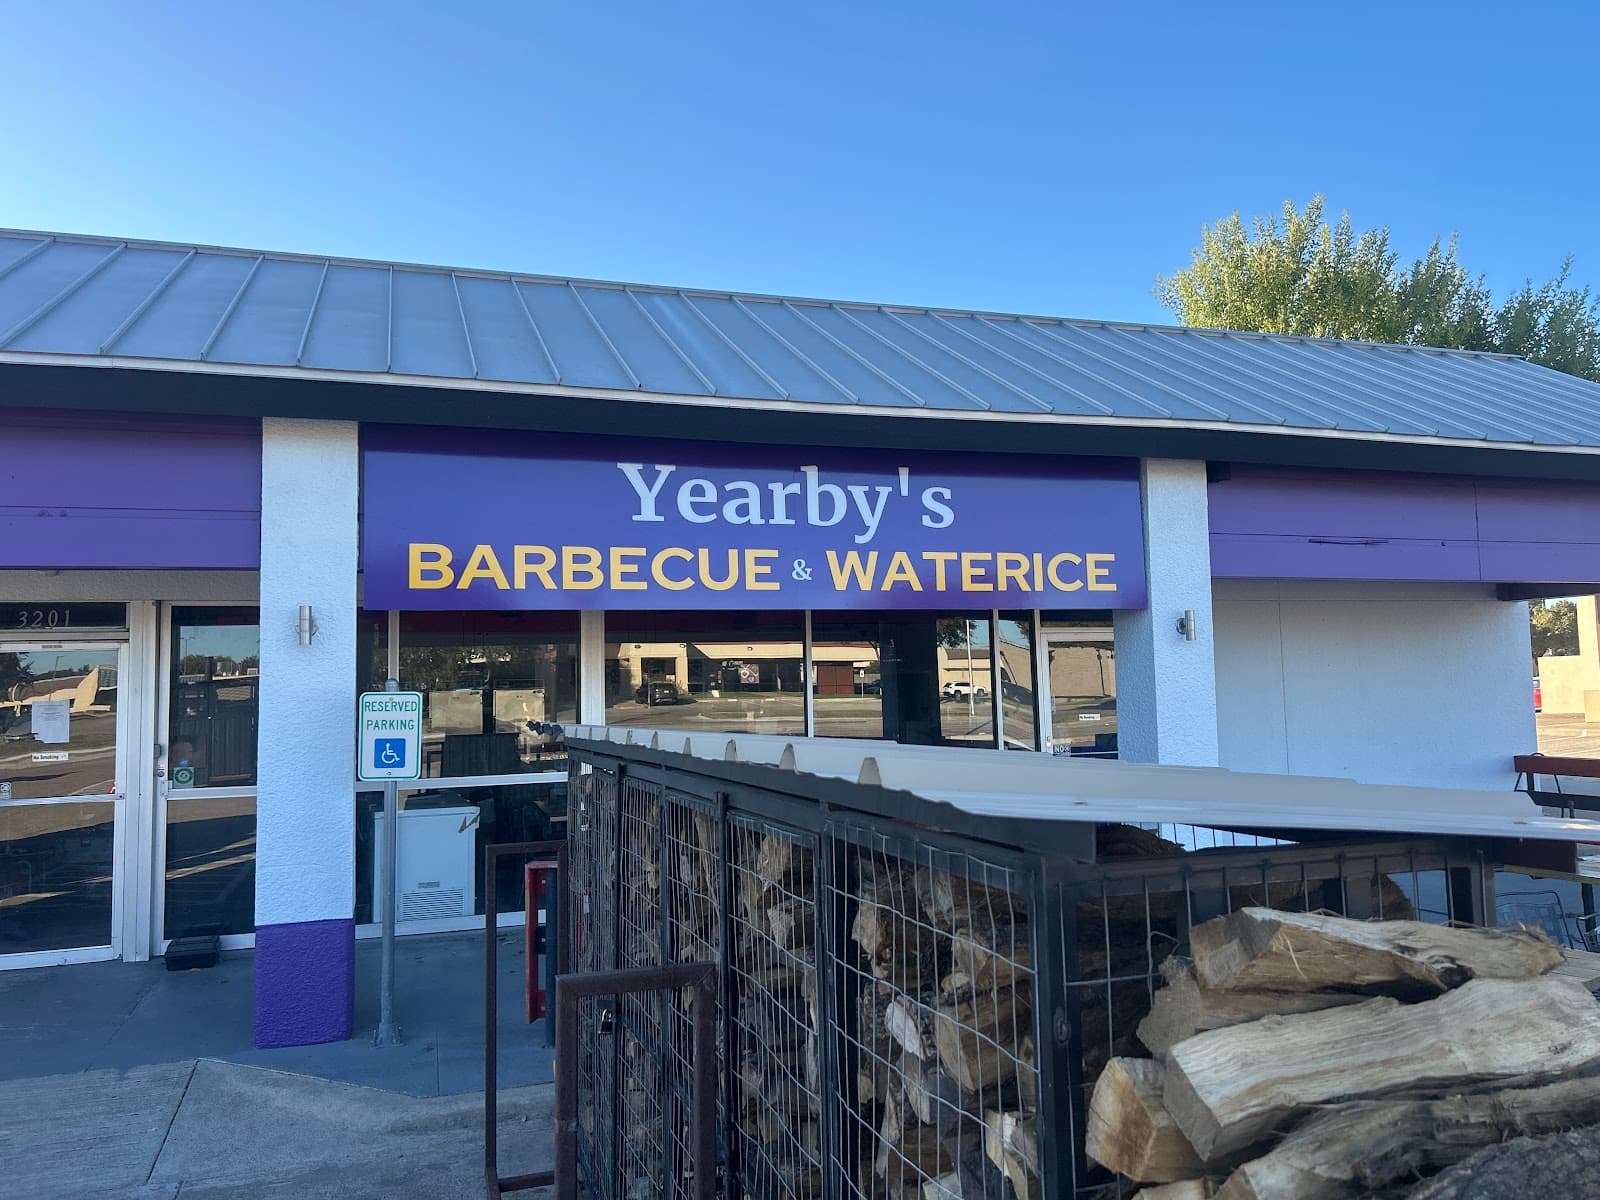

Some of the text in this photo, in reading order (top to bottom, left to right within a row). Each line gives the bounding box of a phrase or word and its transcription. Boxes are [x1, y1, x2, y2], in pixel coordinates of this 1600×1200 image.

[617, 462, 955, 544] Yearby's
[408, 543, 1117, 592] BARBECUE & WATERICE
[17, 609, 70, 628] 3201
[364, 701, 417, 712] RESERVED
[366, 719, 414, 730] PARKING
